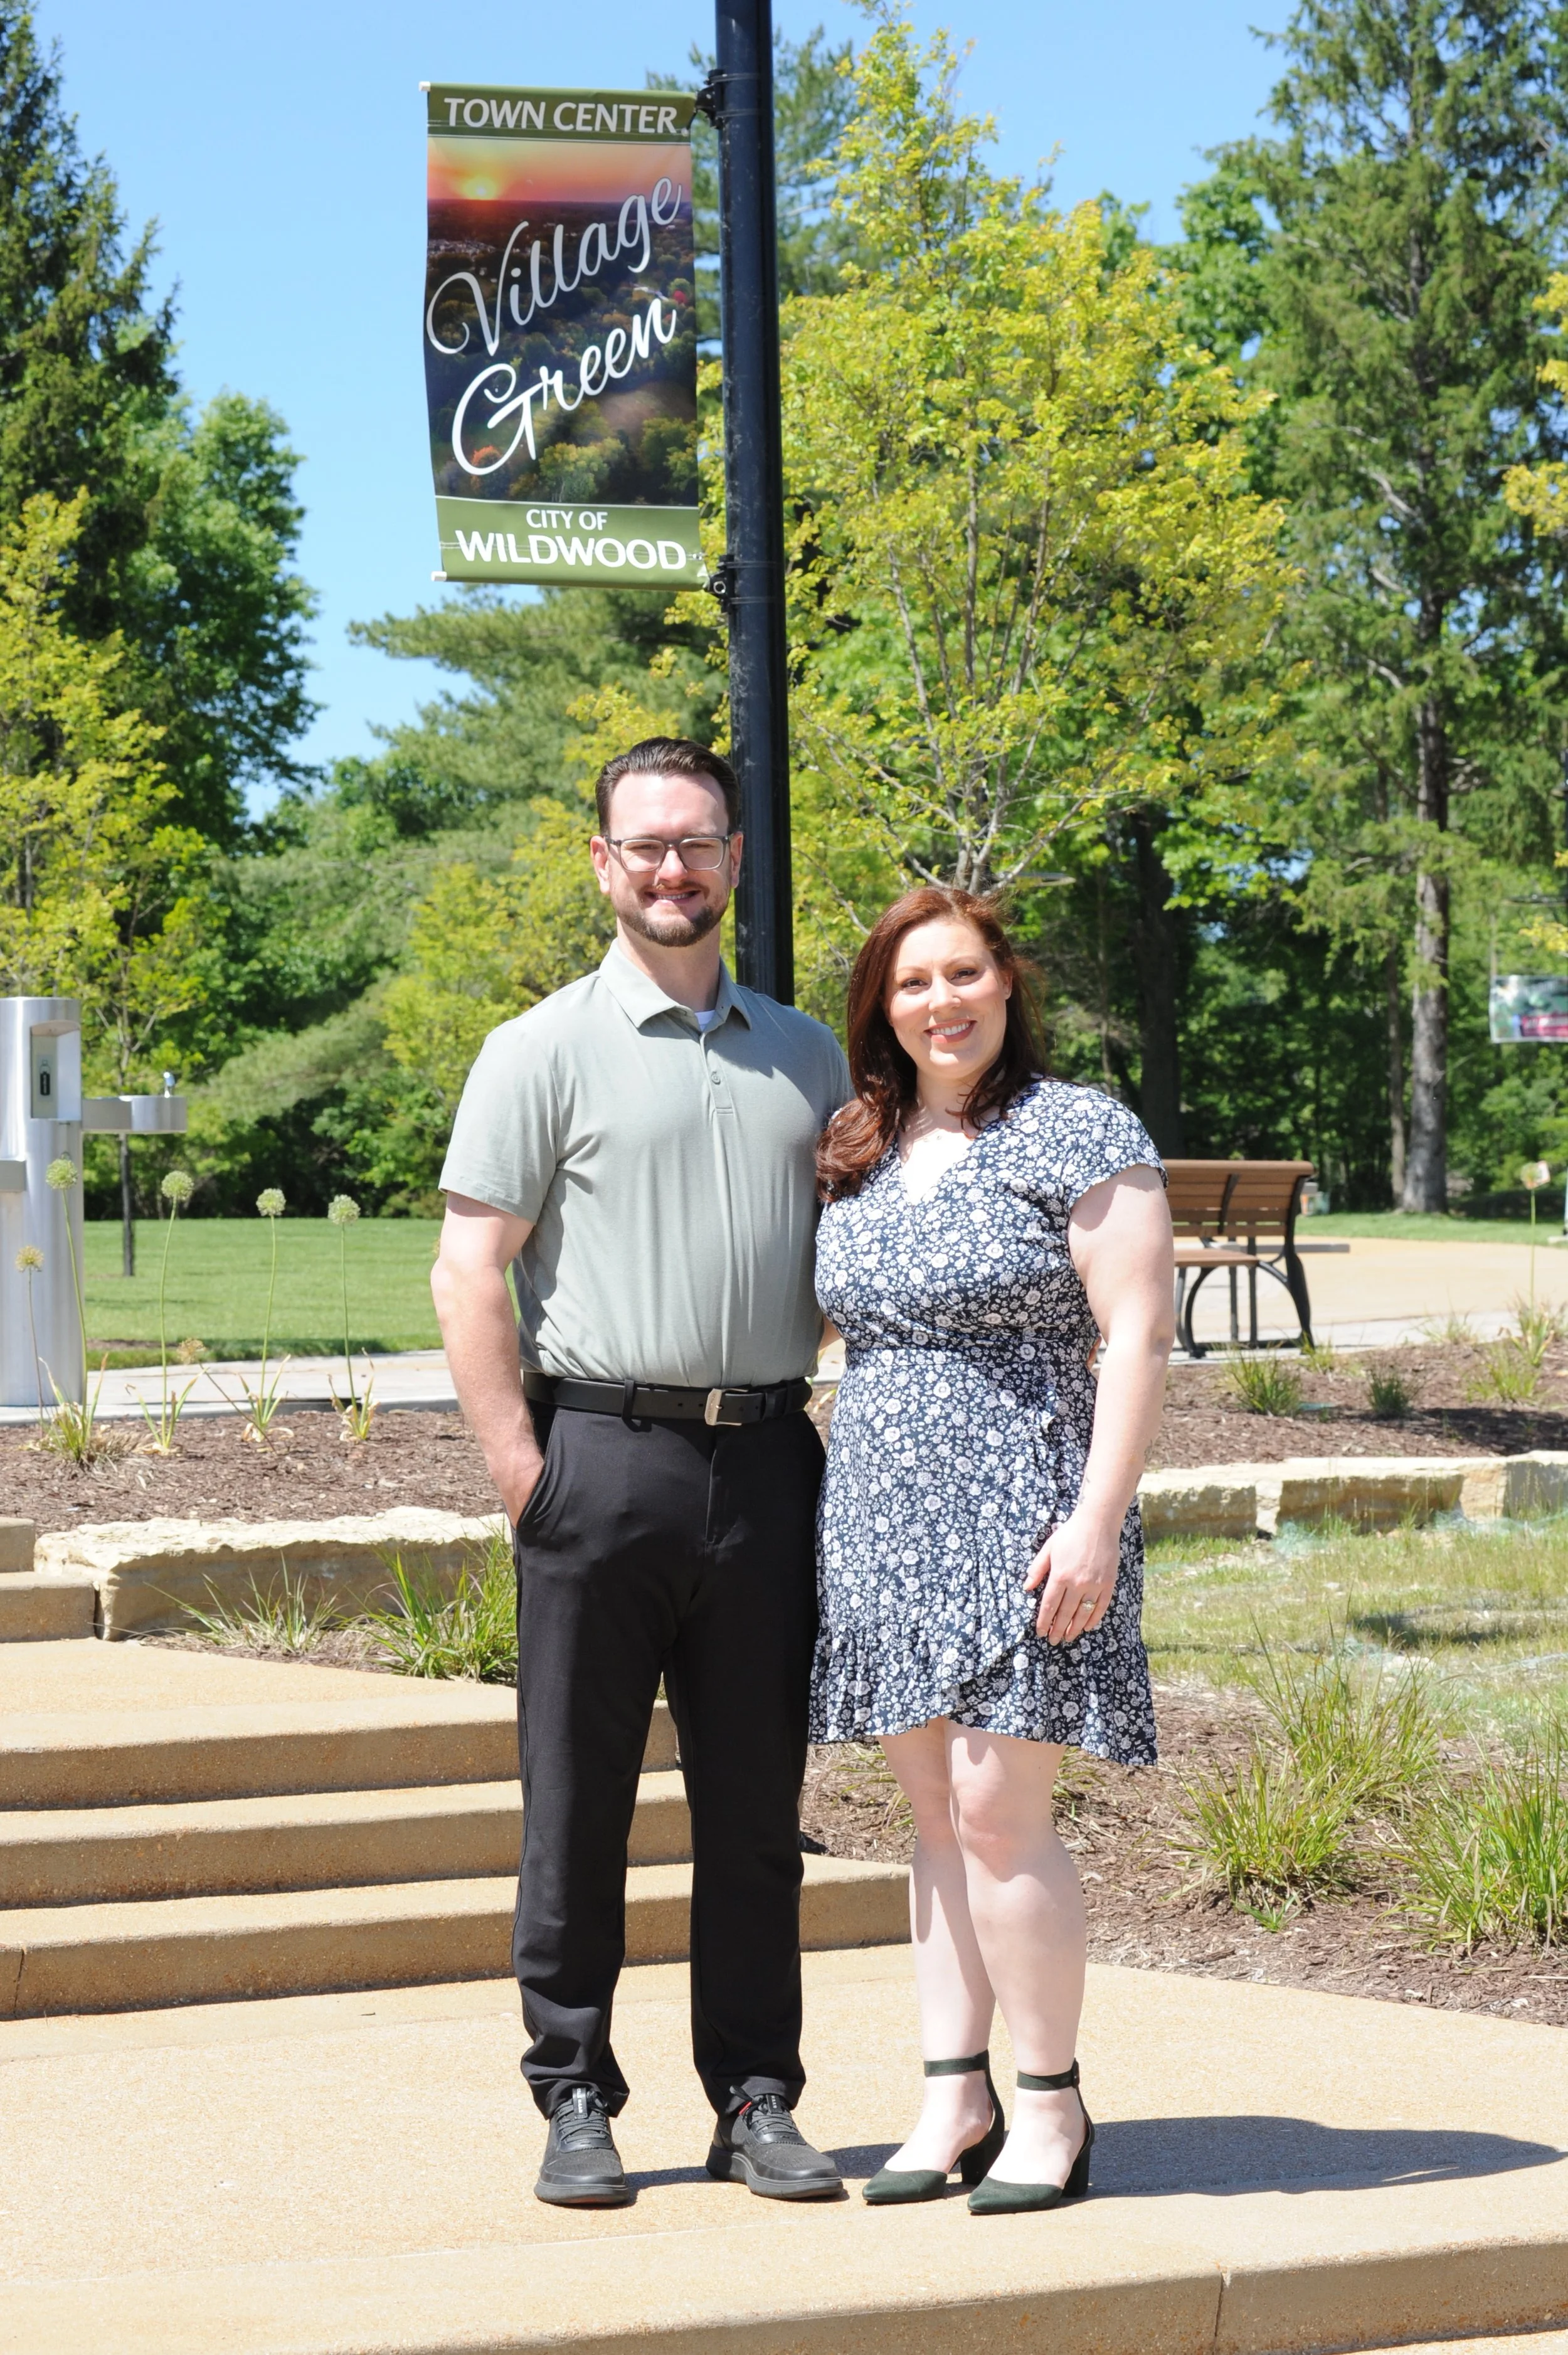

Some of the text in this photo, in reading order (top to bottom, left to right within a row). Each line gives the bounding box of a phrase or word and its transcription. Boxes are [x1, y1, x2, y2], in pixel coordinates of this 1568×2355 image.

[443, 97, 677, 134] TOWN CENTER
[426, 177, 682, 356] Village
[452, 298, 677, 475] Green
[526, 509, 608, 531] CITY OF
[455, 530, 687, 569] WILDWOOD
